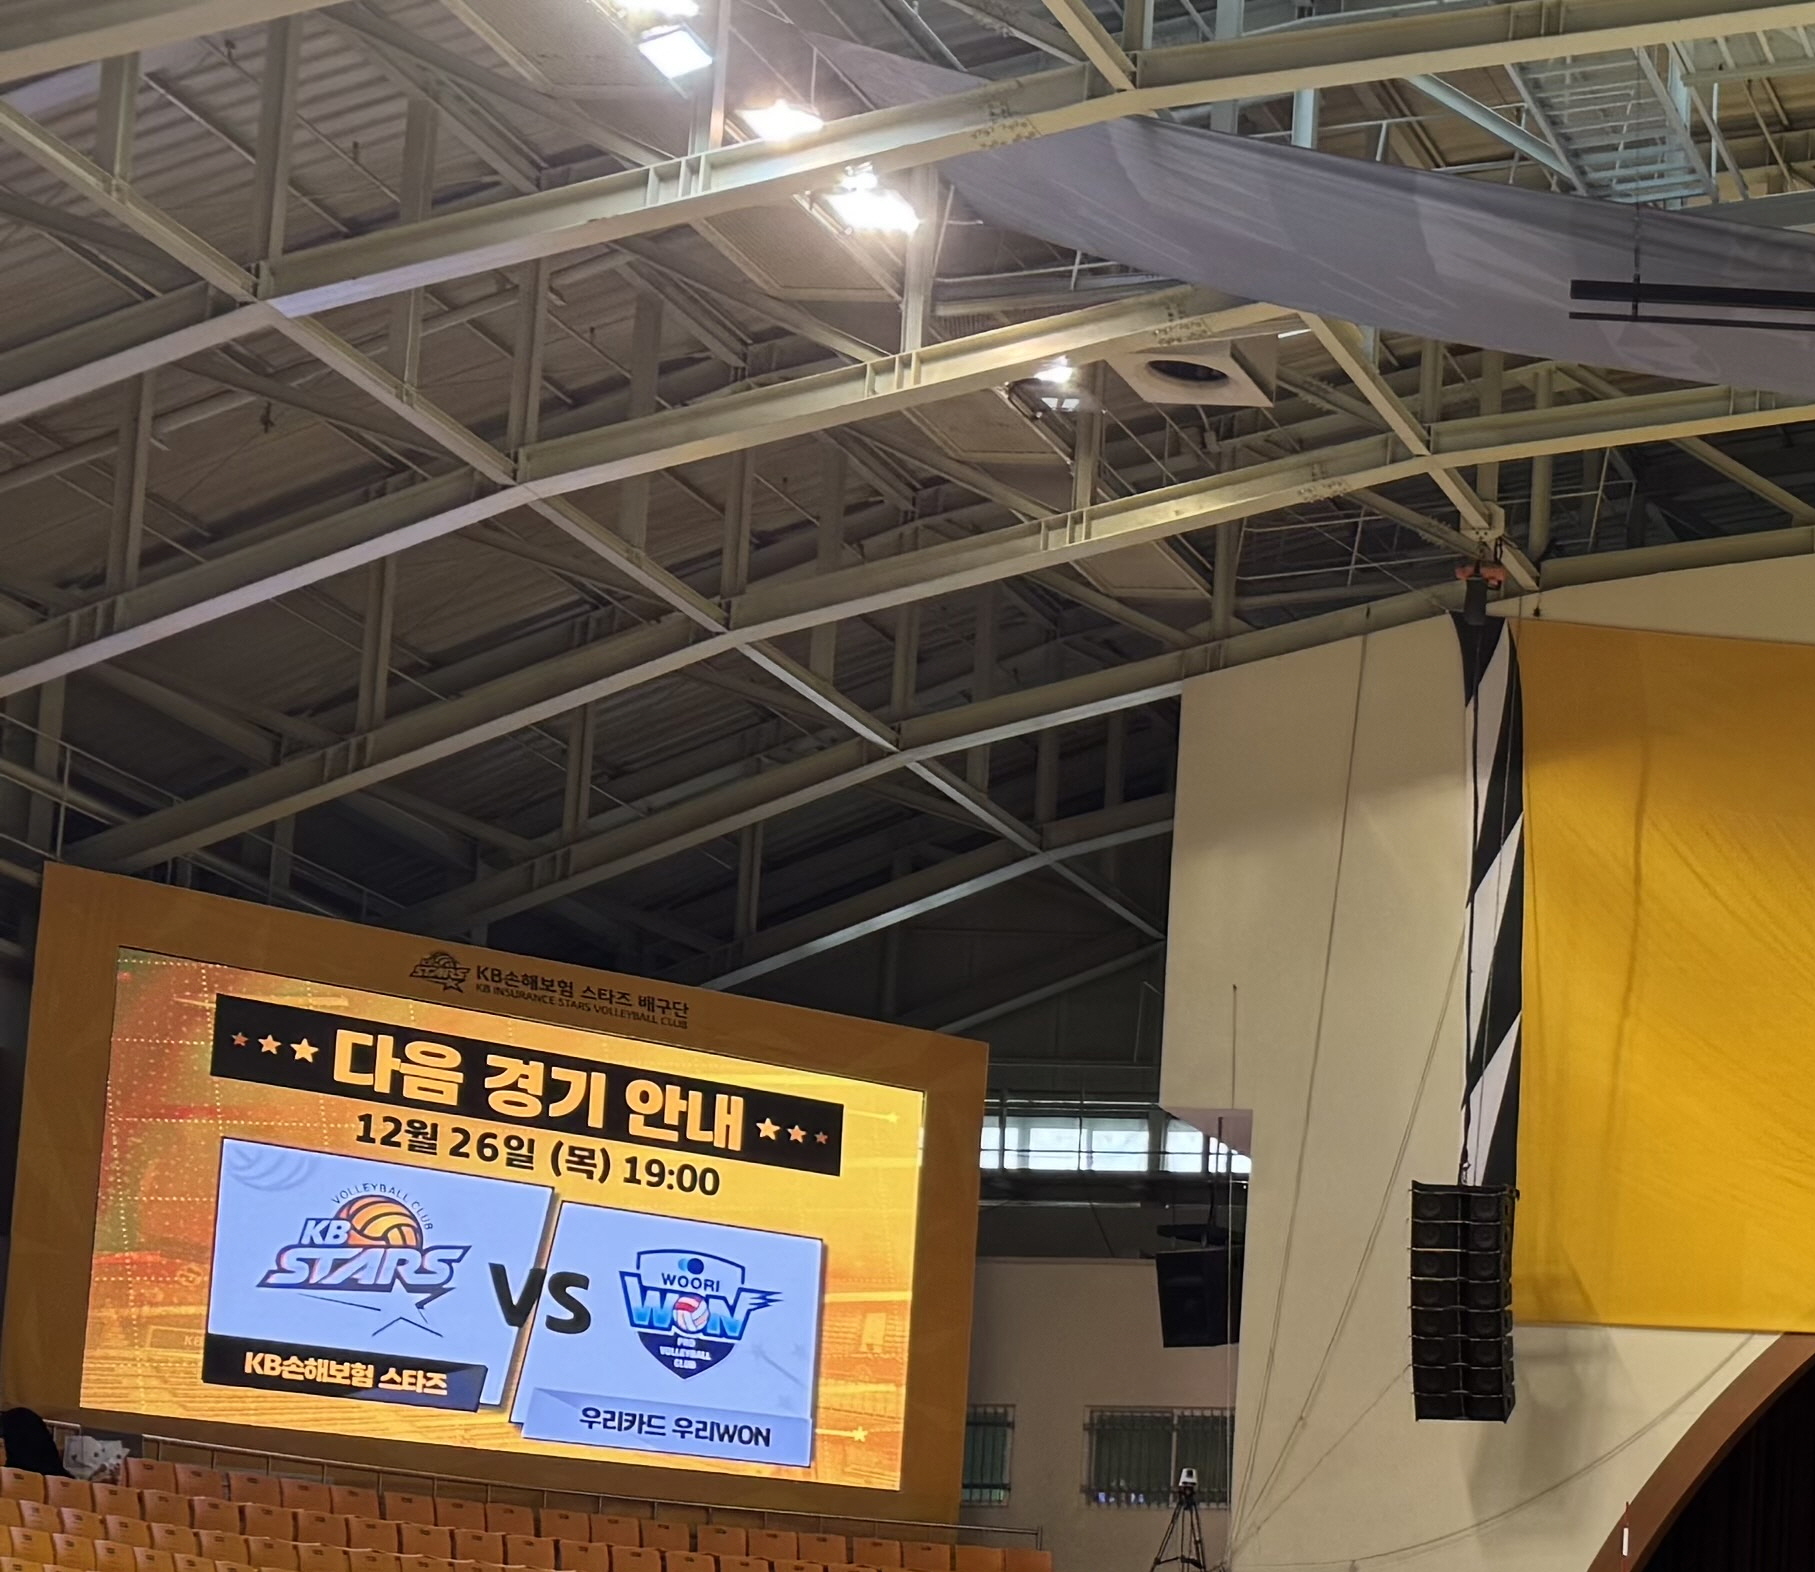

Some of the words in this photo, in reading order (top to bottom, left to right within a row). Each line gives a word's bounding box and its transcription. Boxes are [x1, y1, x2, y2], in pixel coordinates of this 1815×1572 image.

[476, 965, 574, 999] KB손해보험
[581, 985, 633, 1007] 스타즈
[638, 995, 689, 1019] 배구단
[332, 1027, 460, 1110] 다음
[483, 1049, 606, 1133] 경기
[625, 1074, 744, 1155] 안내
[355, 1111, 439, 1158] 12월
[449, 1121, 537, 1171] 26일
[551, 1140, 611, 1185] (목)
[623, 1155, 720, 1197] 19:00
[331, 1183, 409, 1205] VOLLEYBALL
[411, 1200, 434, 1231] CLUB
[300, 1218, 352, 1246] KB
[256, 1244, 472, 1293] STARS
[661, 1272, 720, 1293] WOORI
[488, 1262, 591, 1335] VS
[619, 1270, 752, 1341] WON
[244, 1352, 374, 1388] KB손해보험
[378, 1367, 448, 1396] 스타즈
[579, 1406, 666, 1436] 우리카드
[672, 1418, 770, 1447] 우리WON
